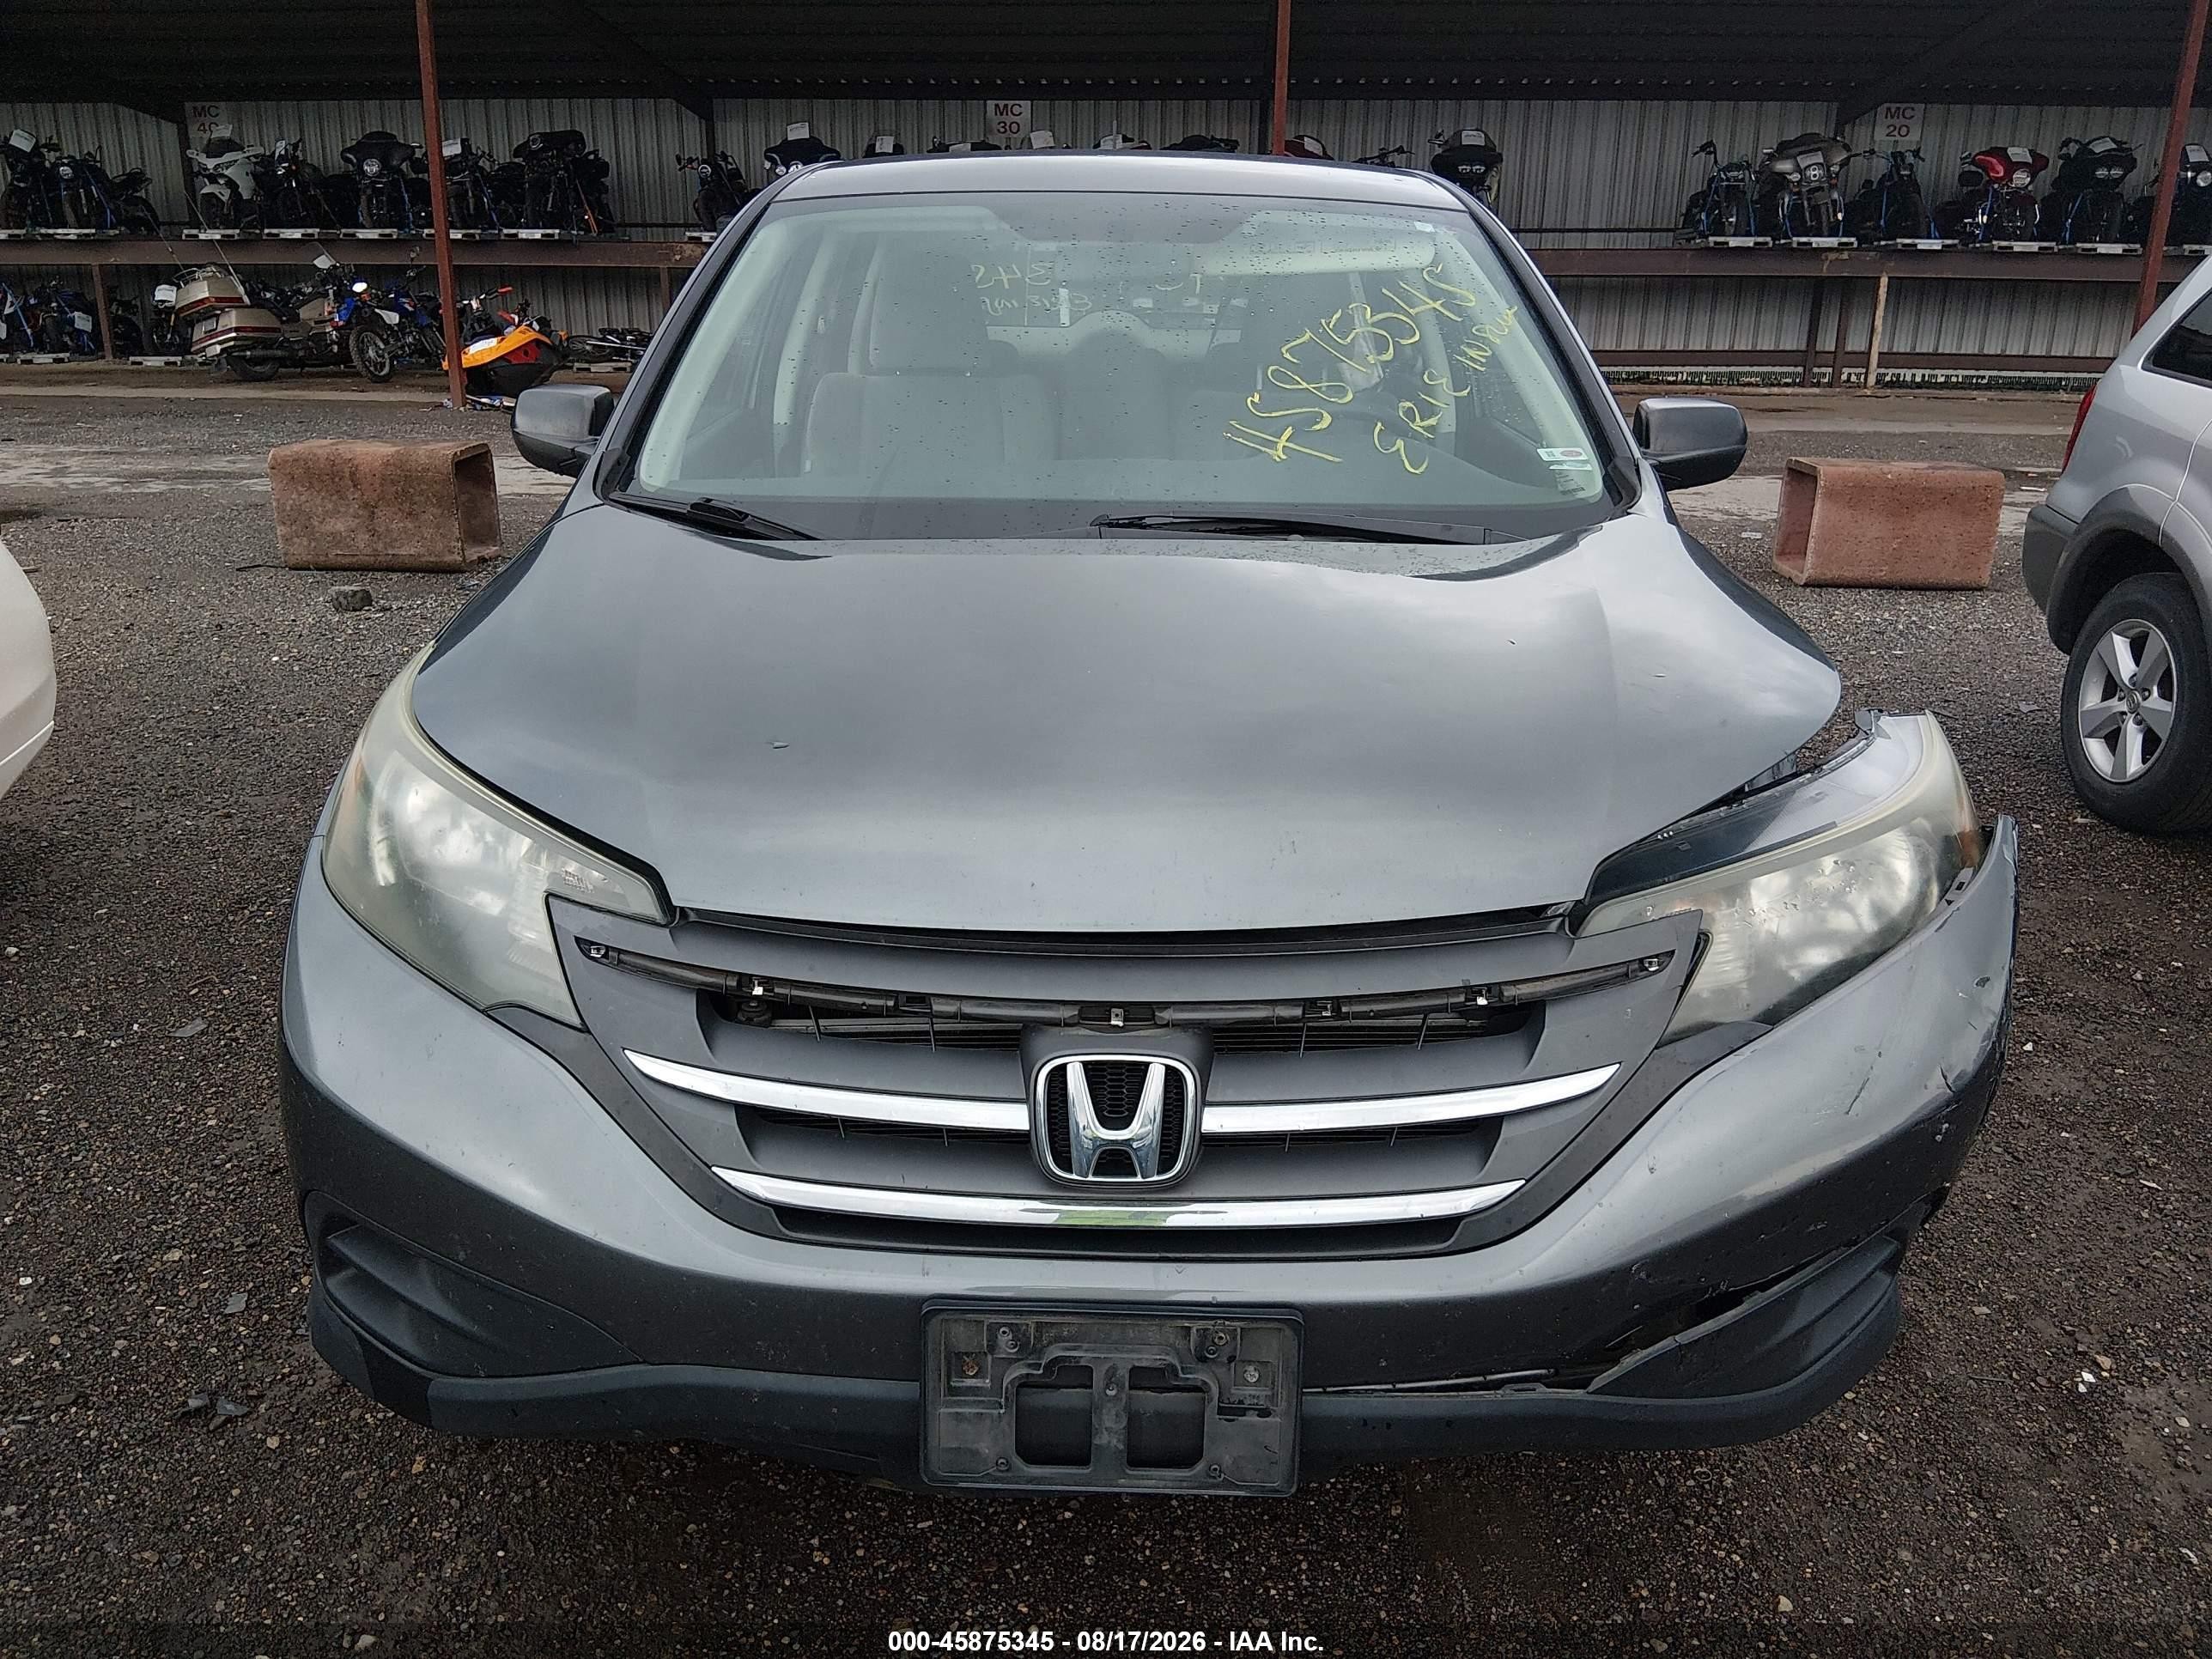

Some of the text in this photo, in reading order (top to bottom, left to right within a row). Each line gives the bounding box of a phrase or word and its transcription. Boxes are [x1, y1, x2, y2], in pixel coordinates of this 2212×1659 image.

[191, 105, 220, 118] MC
[994, 103, 1023, 117] MC
[1884, 106, 1916, 120] MC
[997, 120, 1020, 135] 30
[1885, 124, 1911, 138] 20
[1374, 368, 1470, 474] ERIE
